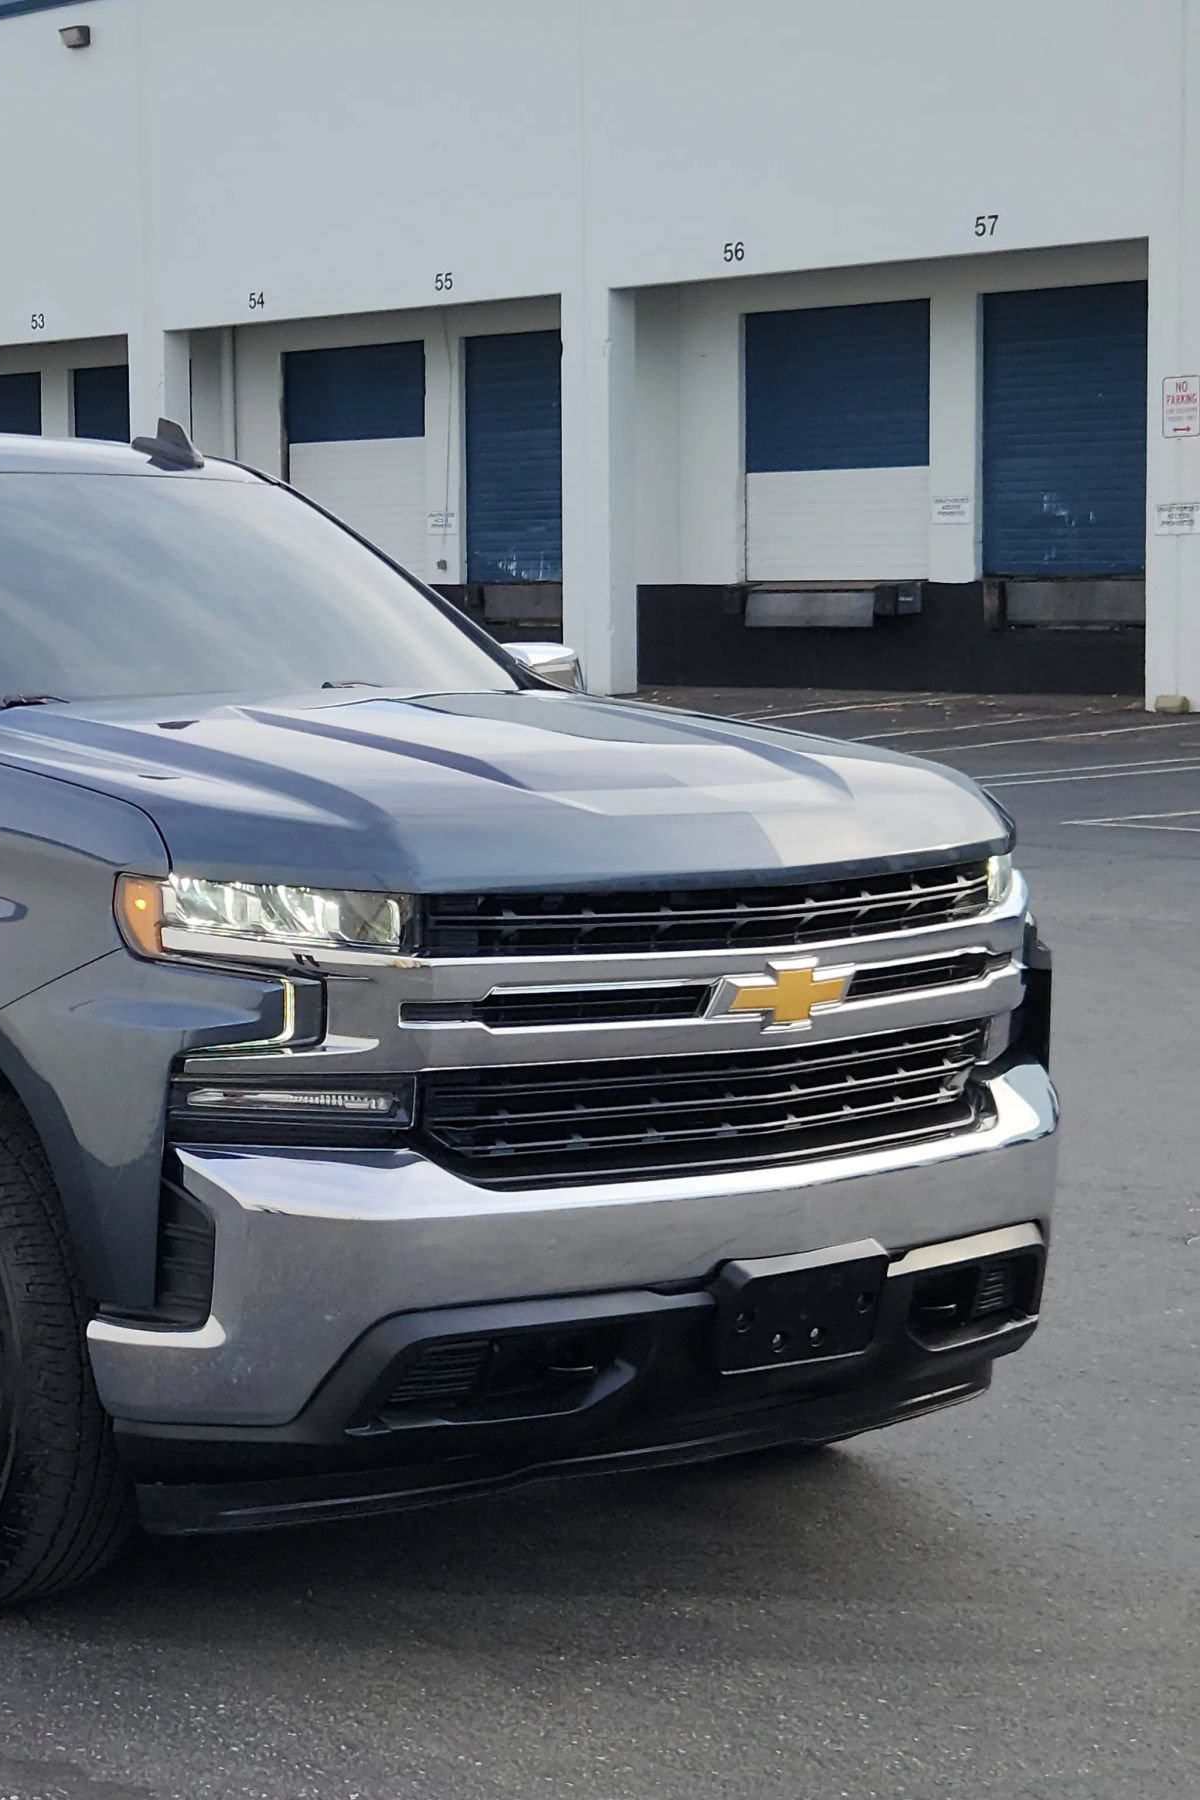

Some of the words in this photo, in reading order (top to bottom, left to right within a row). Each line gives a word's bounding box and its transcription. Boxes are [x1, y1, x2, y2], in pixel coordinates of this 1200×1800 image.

[974, 214, 999, 238] 57
[723, 241, 745, 263] 56
[434, 272, 454, 292] 55
[248, 291, 265, 310] 54
[30, 313, 45, 330] 53
[1175, 381, 1188, 393] NO
[1166, 393, 1197, 406] PARKING
